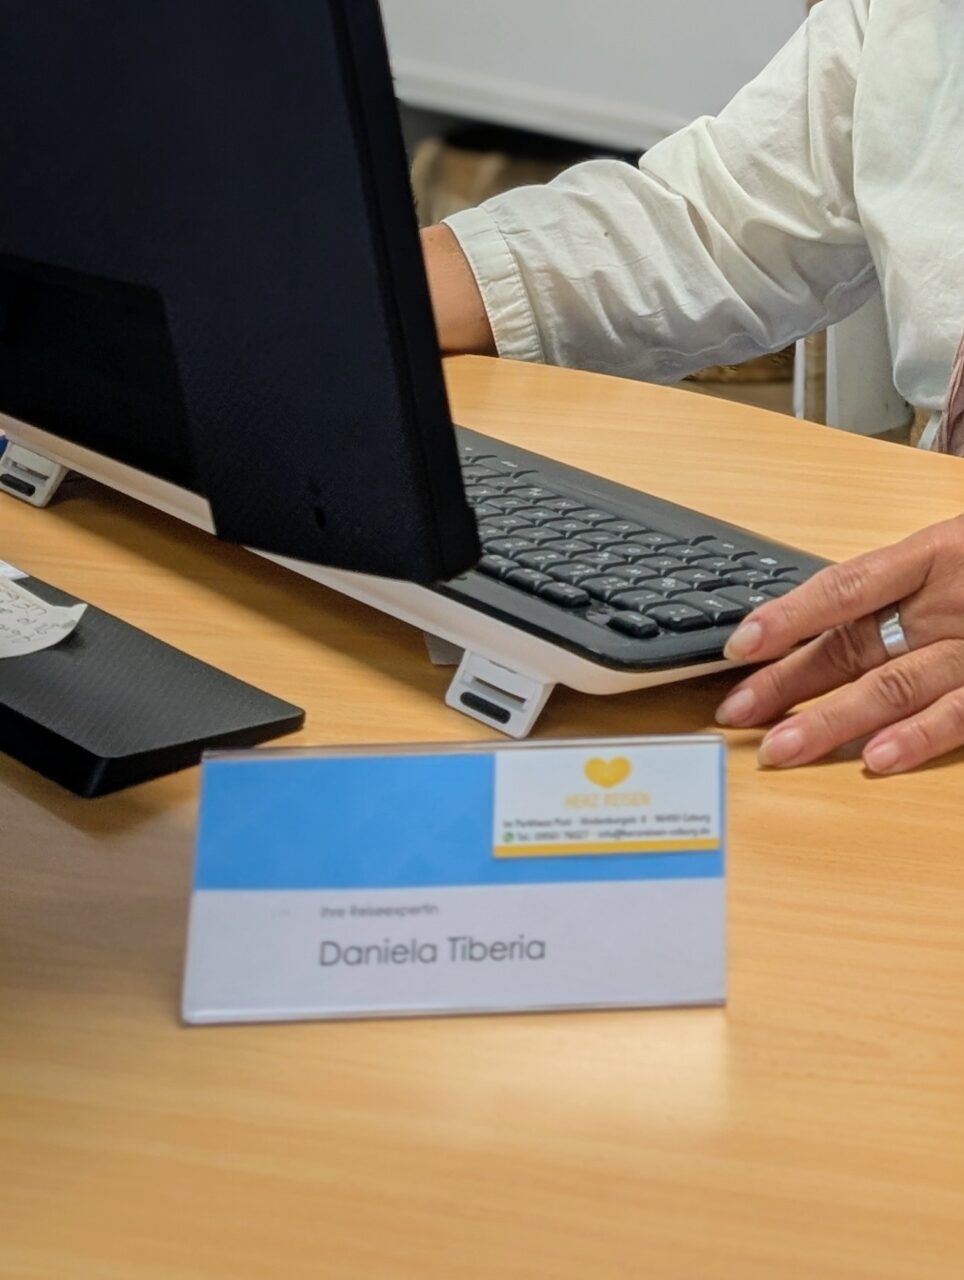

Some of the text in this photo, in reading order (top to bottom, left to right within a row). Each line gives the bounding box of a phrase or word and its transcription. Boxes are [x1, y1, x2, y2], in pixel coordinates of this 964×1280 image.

[320, 902, 440, 920] Ihre Reiseexpertin
[319, 934, 546, 967] Daniela Tiberia
